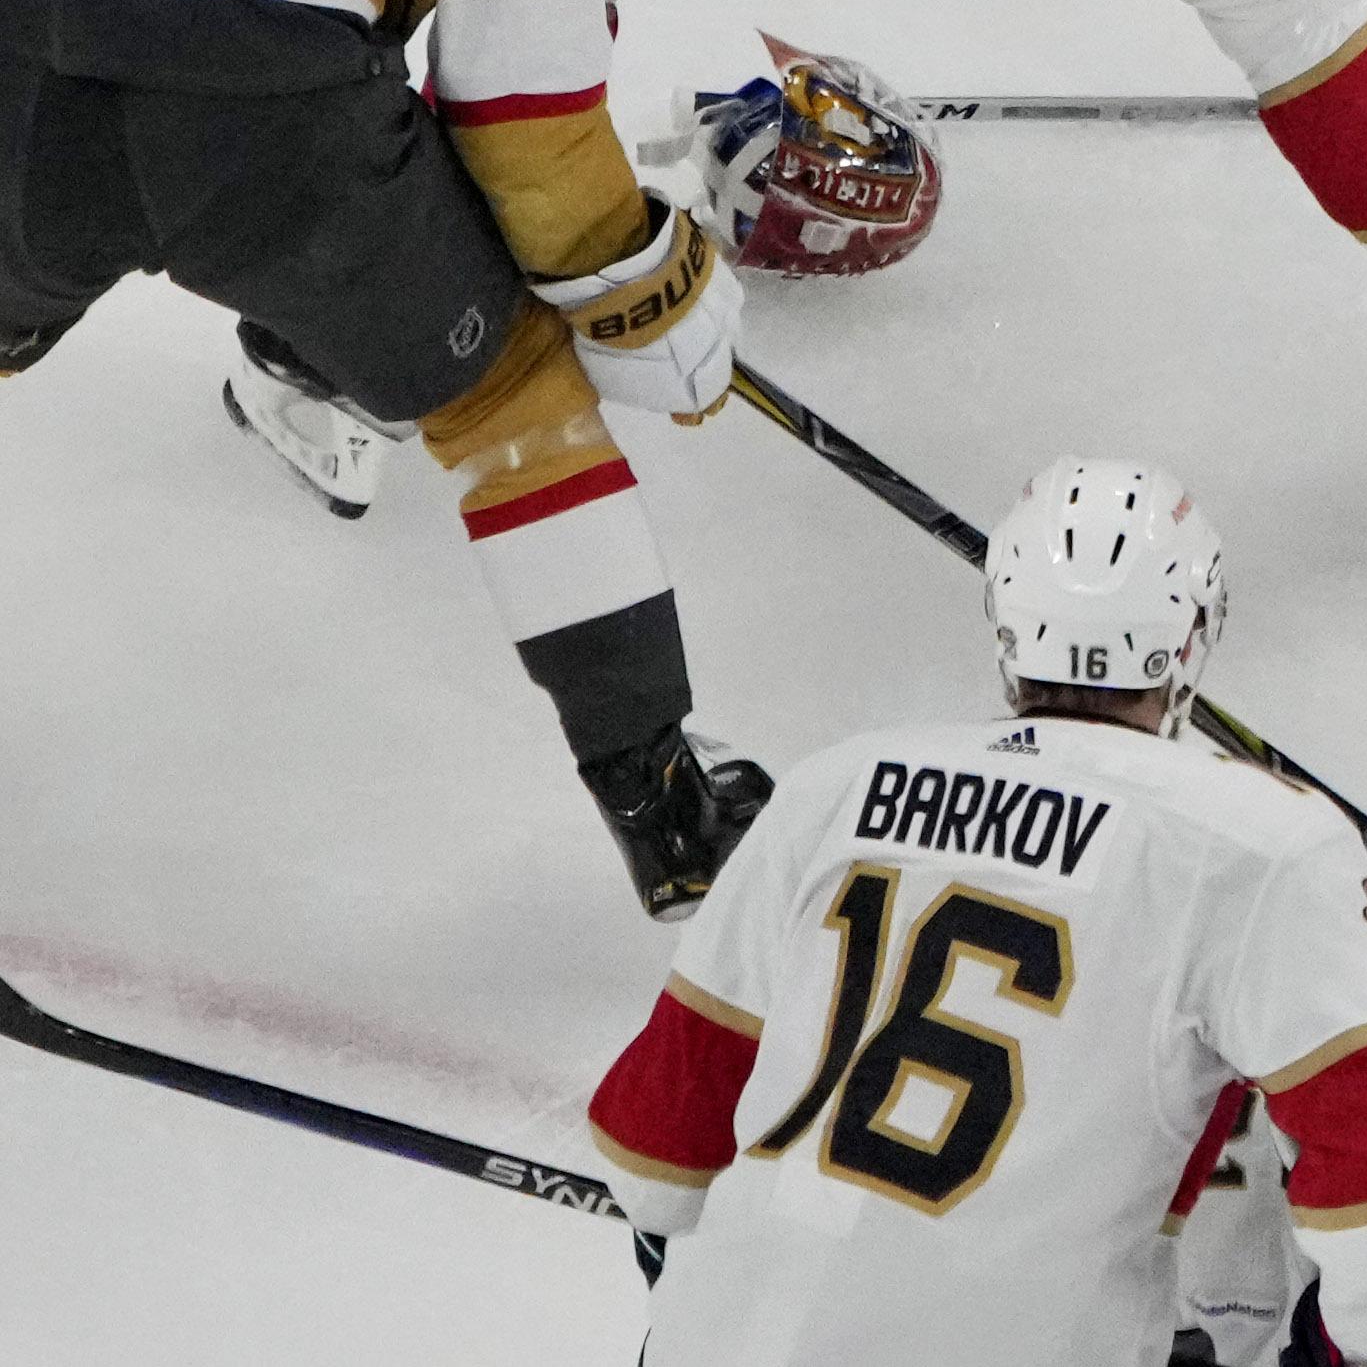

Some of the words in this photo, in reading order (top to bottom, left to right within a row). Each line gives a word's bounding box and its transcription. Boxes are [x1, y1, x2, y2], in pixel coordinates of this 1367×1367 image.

[1069, 645, 1109, 681] 16
[855, 761, 1112, 877] BARKOV
[744, 861, 1076, 1218] 16
